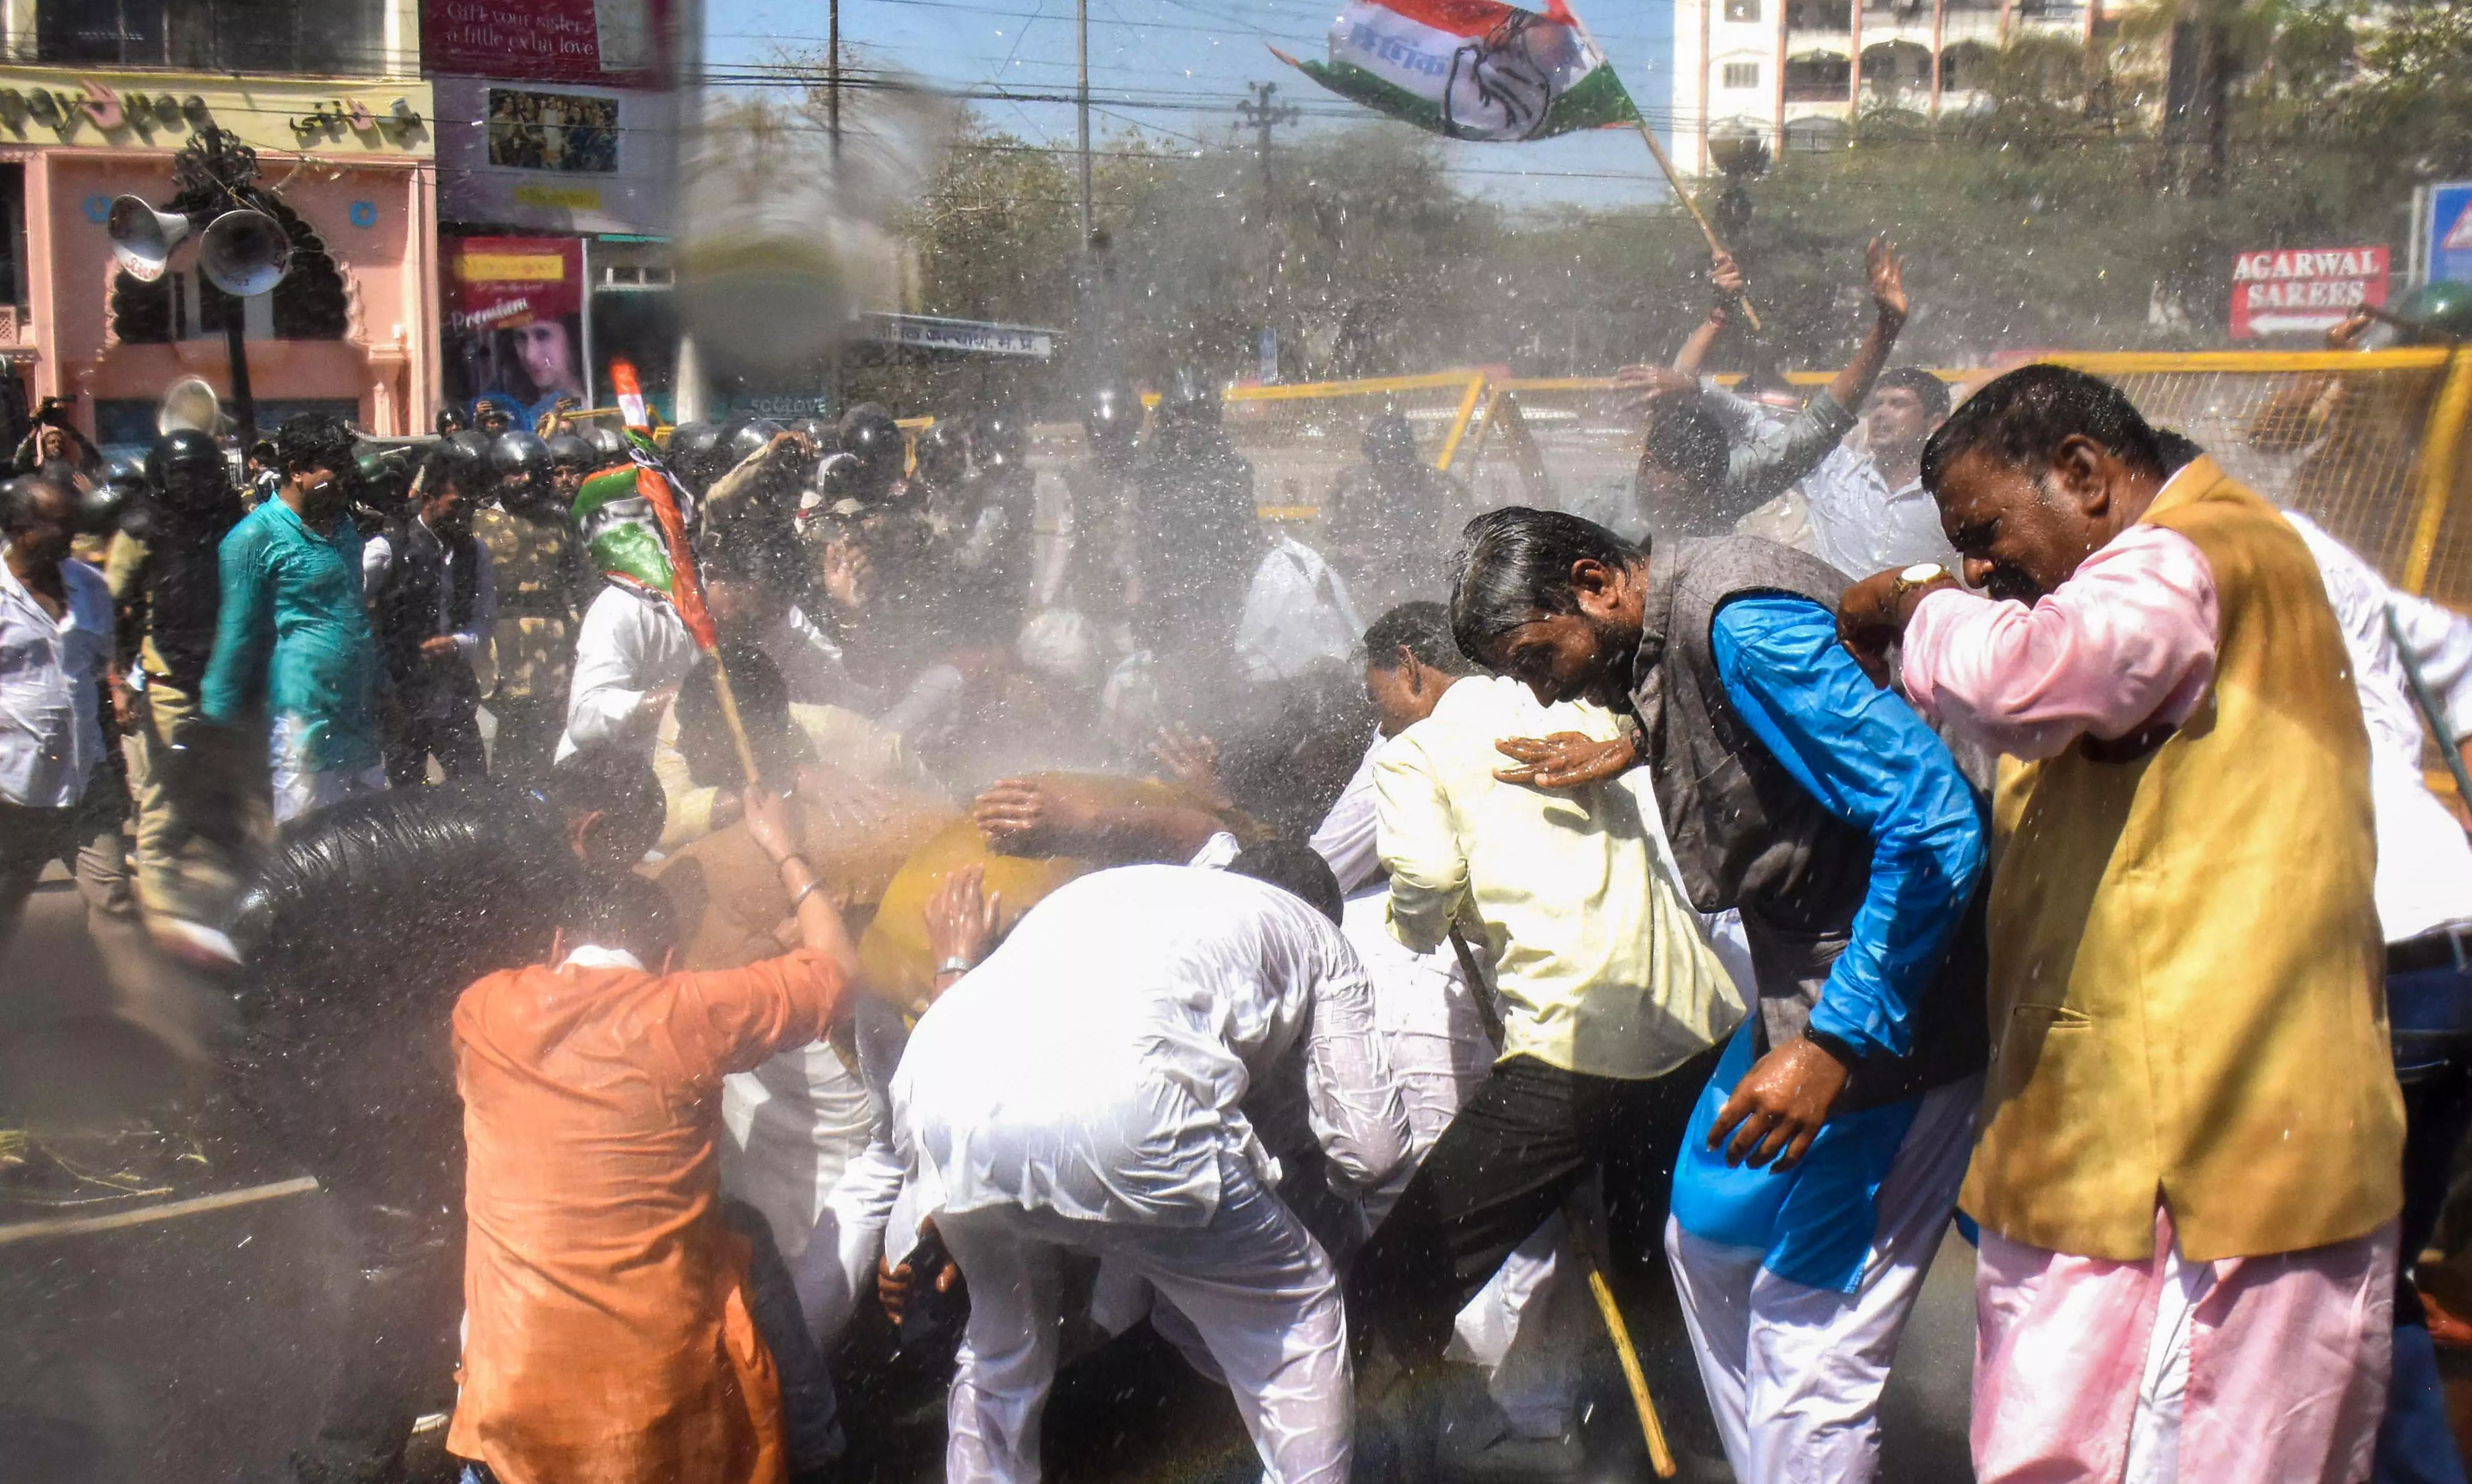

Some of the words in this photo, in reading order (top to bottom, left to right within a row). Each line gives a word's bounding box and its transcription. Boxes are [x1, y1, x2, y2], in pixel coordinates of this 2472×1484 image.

[560, 36, 594, 55] love
[2233, 251, 2381, 280] AGARWAL
[2247, 281, 2365, 308] SAREES
